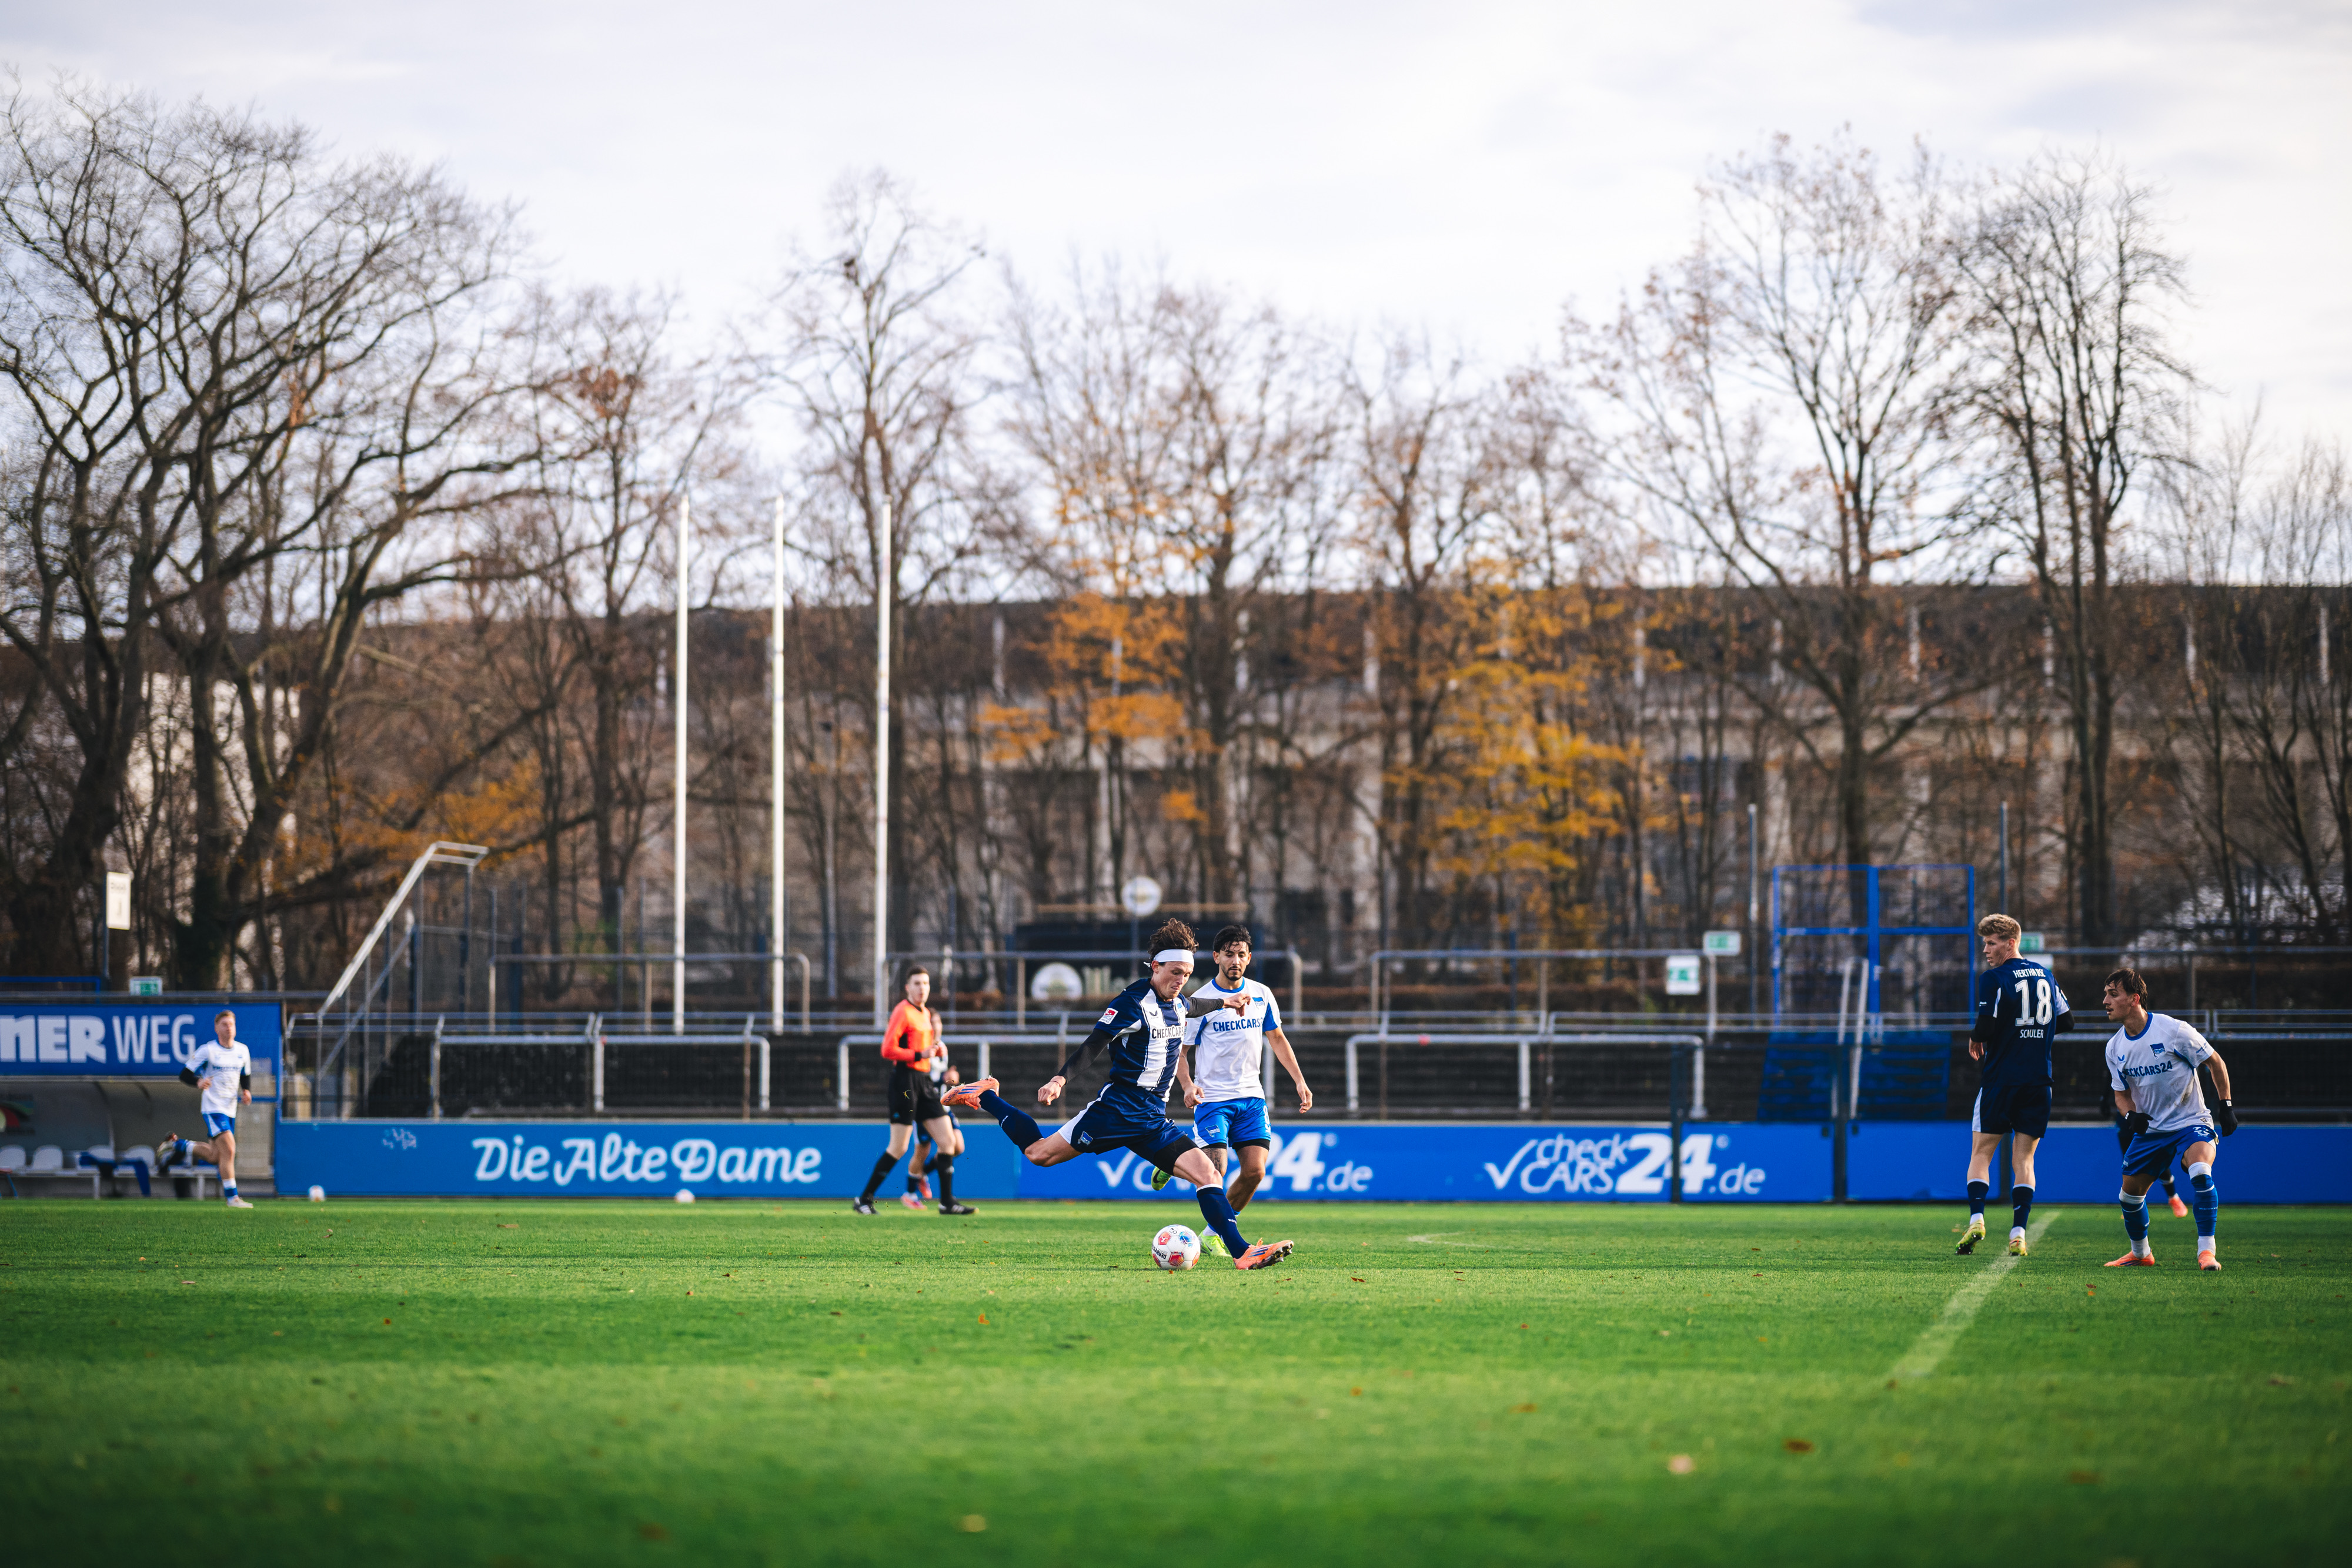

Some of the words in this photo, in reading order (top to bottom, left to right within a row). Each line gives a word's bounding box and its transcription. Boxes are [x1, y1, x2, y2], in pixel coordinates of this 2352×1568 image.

[2013, 968, 2037, 978] HERTHA
[2014, 979, 2052, 1025] 18
[112, 1014, 196, 1064] WEG
[2122, 1060, 2173, 1079] ECKCARS24
[1263, 1105, 1269, 1125] 8
[472, 1135, 550, 1181] Die
[553, 1132, 667, 1186] Alte
[670, 1139, 822, 1182] Dame
[1536, 1134, 1629, 1164] check
[1520, 1161, 1614, 1194] CARS
